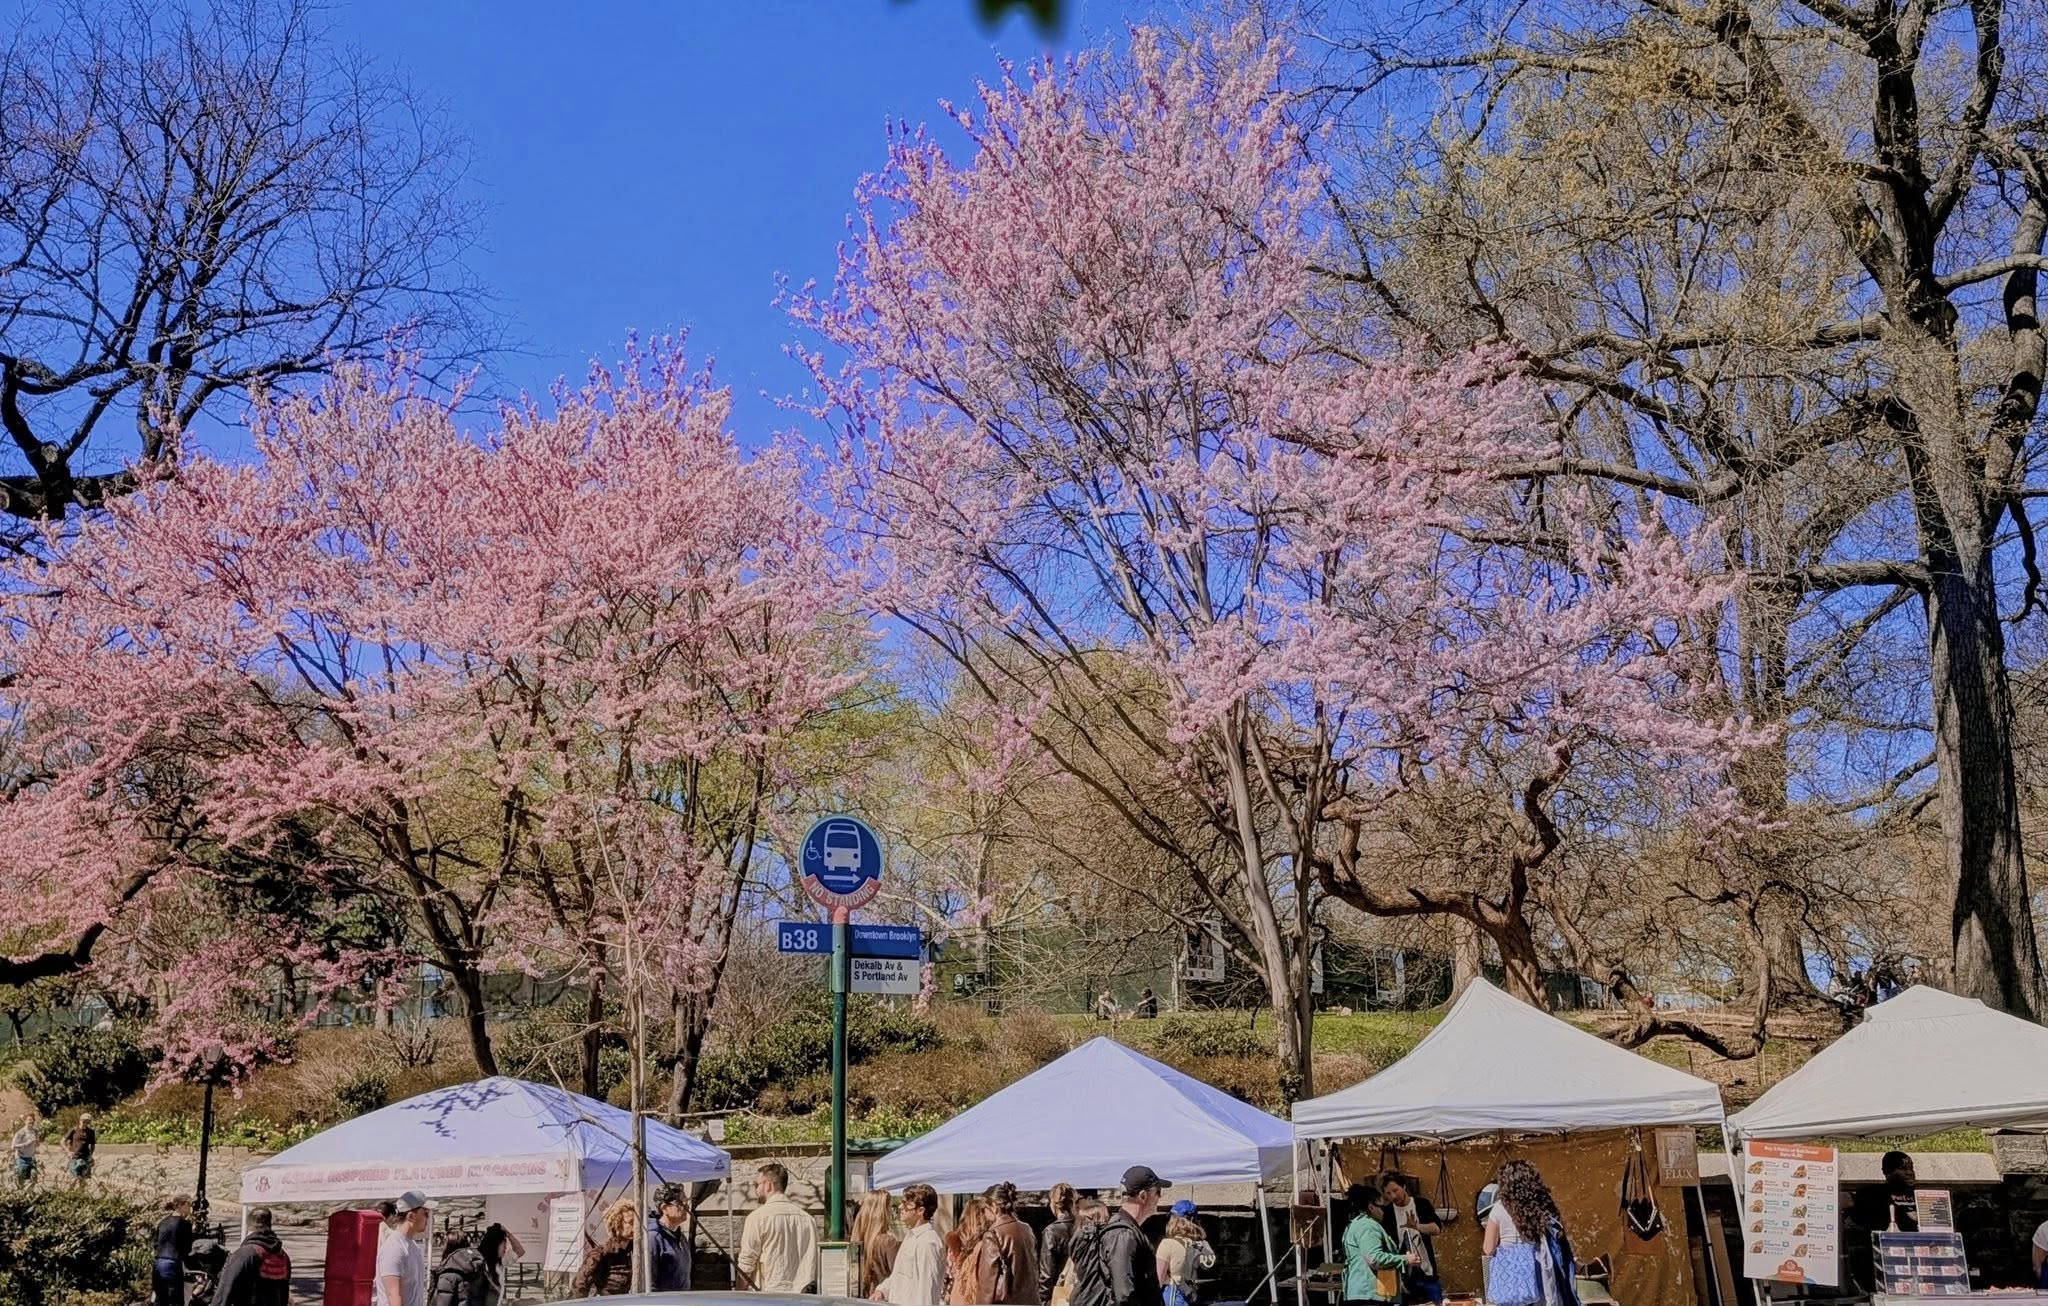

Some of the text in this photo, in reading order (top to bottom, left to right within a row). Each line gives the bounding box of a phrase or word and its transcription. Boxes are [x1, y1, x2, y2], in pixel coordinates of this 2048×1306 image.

[809, 881, 875, 906] NO STANDING
[782, 929, 818, 950] B38
[855, 930, 917, 943] Downtown Brooklyn
[854, 960, 904, 971] Dekalb Av &
[854, 971, 909, 982] S Portland Av
[327, 1168, 391, 1184] INSPIRED
[394, 1165, 465, 1181] FLAVORED
[467, 1161, 547, 1179] MACARONS
